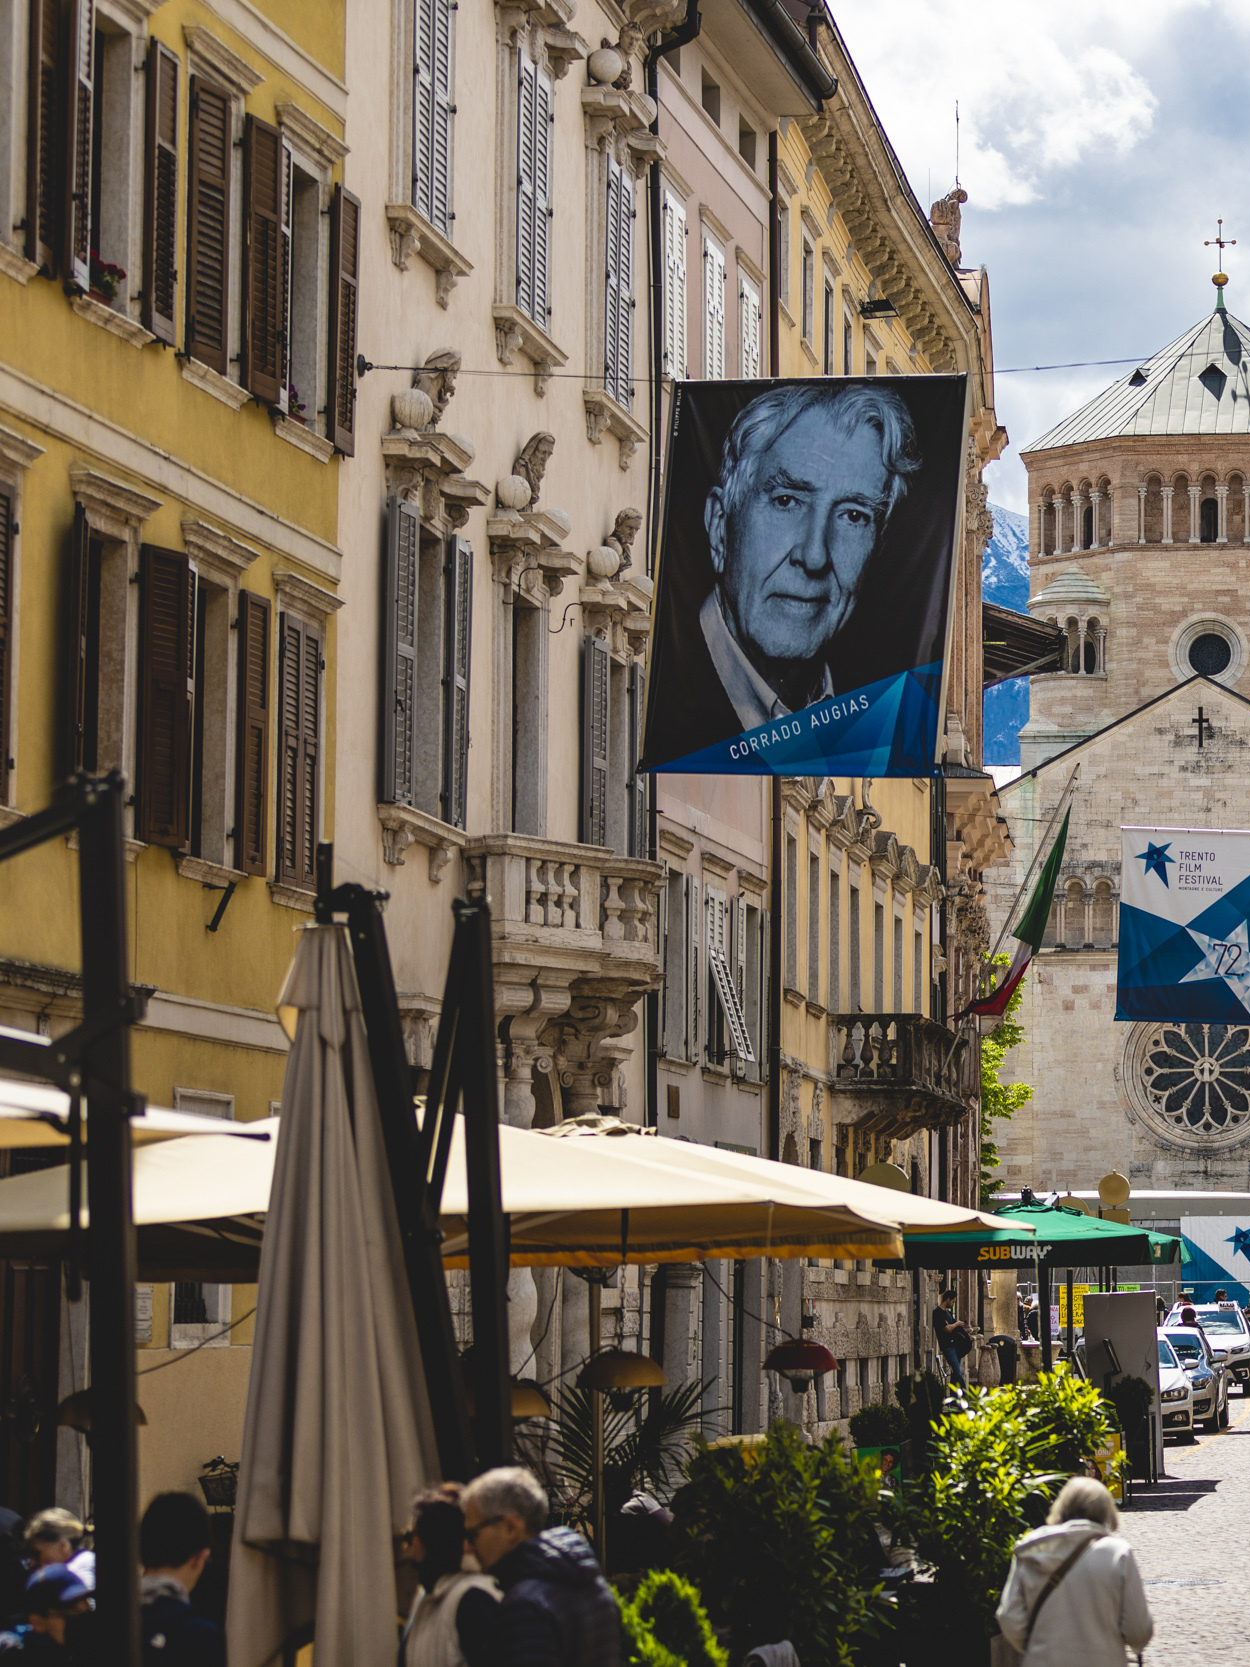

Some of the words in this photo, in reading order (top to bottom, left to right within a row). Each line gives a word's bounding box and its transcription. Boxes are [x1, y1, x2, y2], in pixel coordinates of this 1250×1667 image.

[729, 720, 802, 760] CORRADO
[810, 694, 870, 729] AUGIAS
[1179, 851, 1216, 861] TRENTO
[1179, 862, 1202, 872] FILM
[1179, 875, 1223, 885] FESTIVAL
[1212, 943, 1245, 977] 72.
[977, 1245, 1053, 1262] SUBWAY
